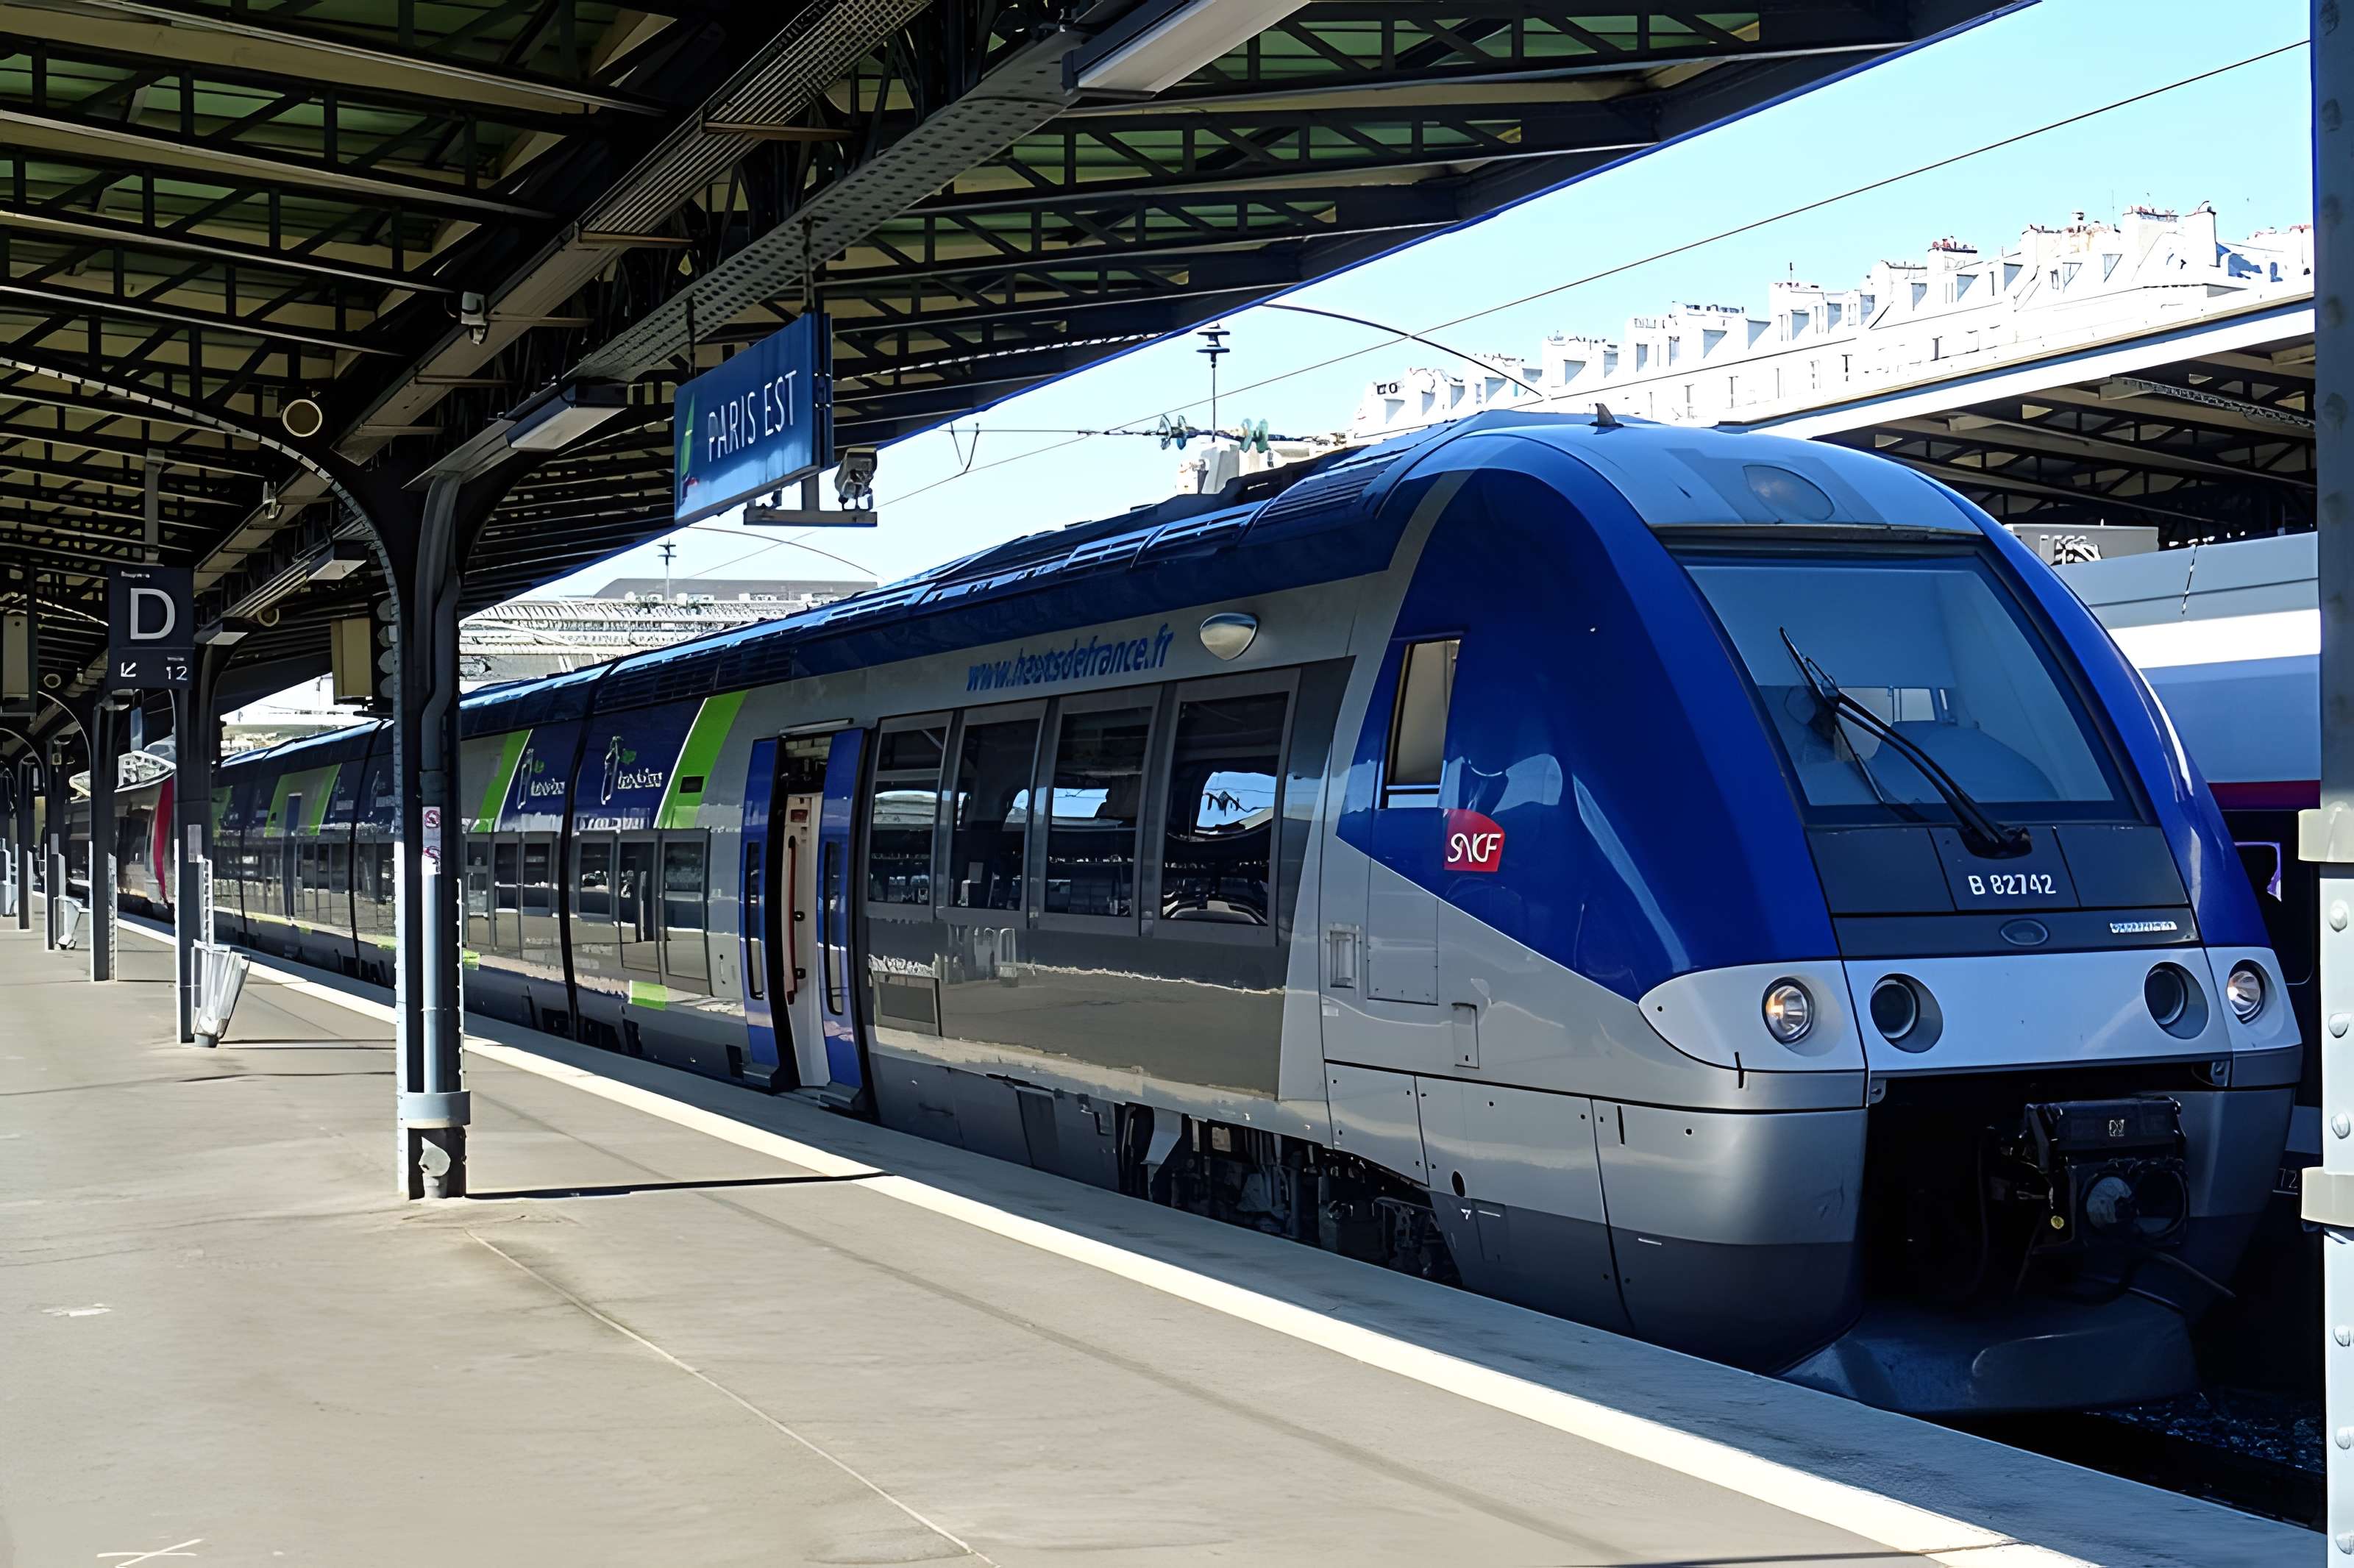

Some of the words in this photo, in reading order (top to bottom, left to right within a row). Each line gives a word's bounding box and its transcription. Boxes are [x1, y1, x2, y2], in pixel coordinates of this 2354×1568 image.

[707, 391, 756, 463] PARIS
[764, 370, 797, 437] EST
[130, 588, 176, 640] D
[166, 666, 188, 681] 12
[1447, 833, 1501, 863] SNCF
[1967, 874, 1986, 895] B
[1989, 874, 2057, 894] 82742
